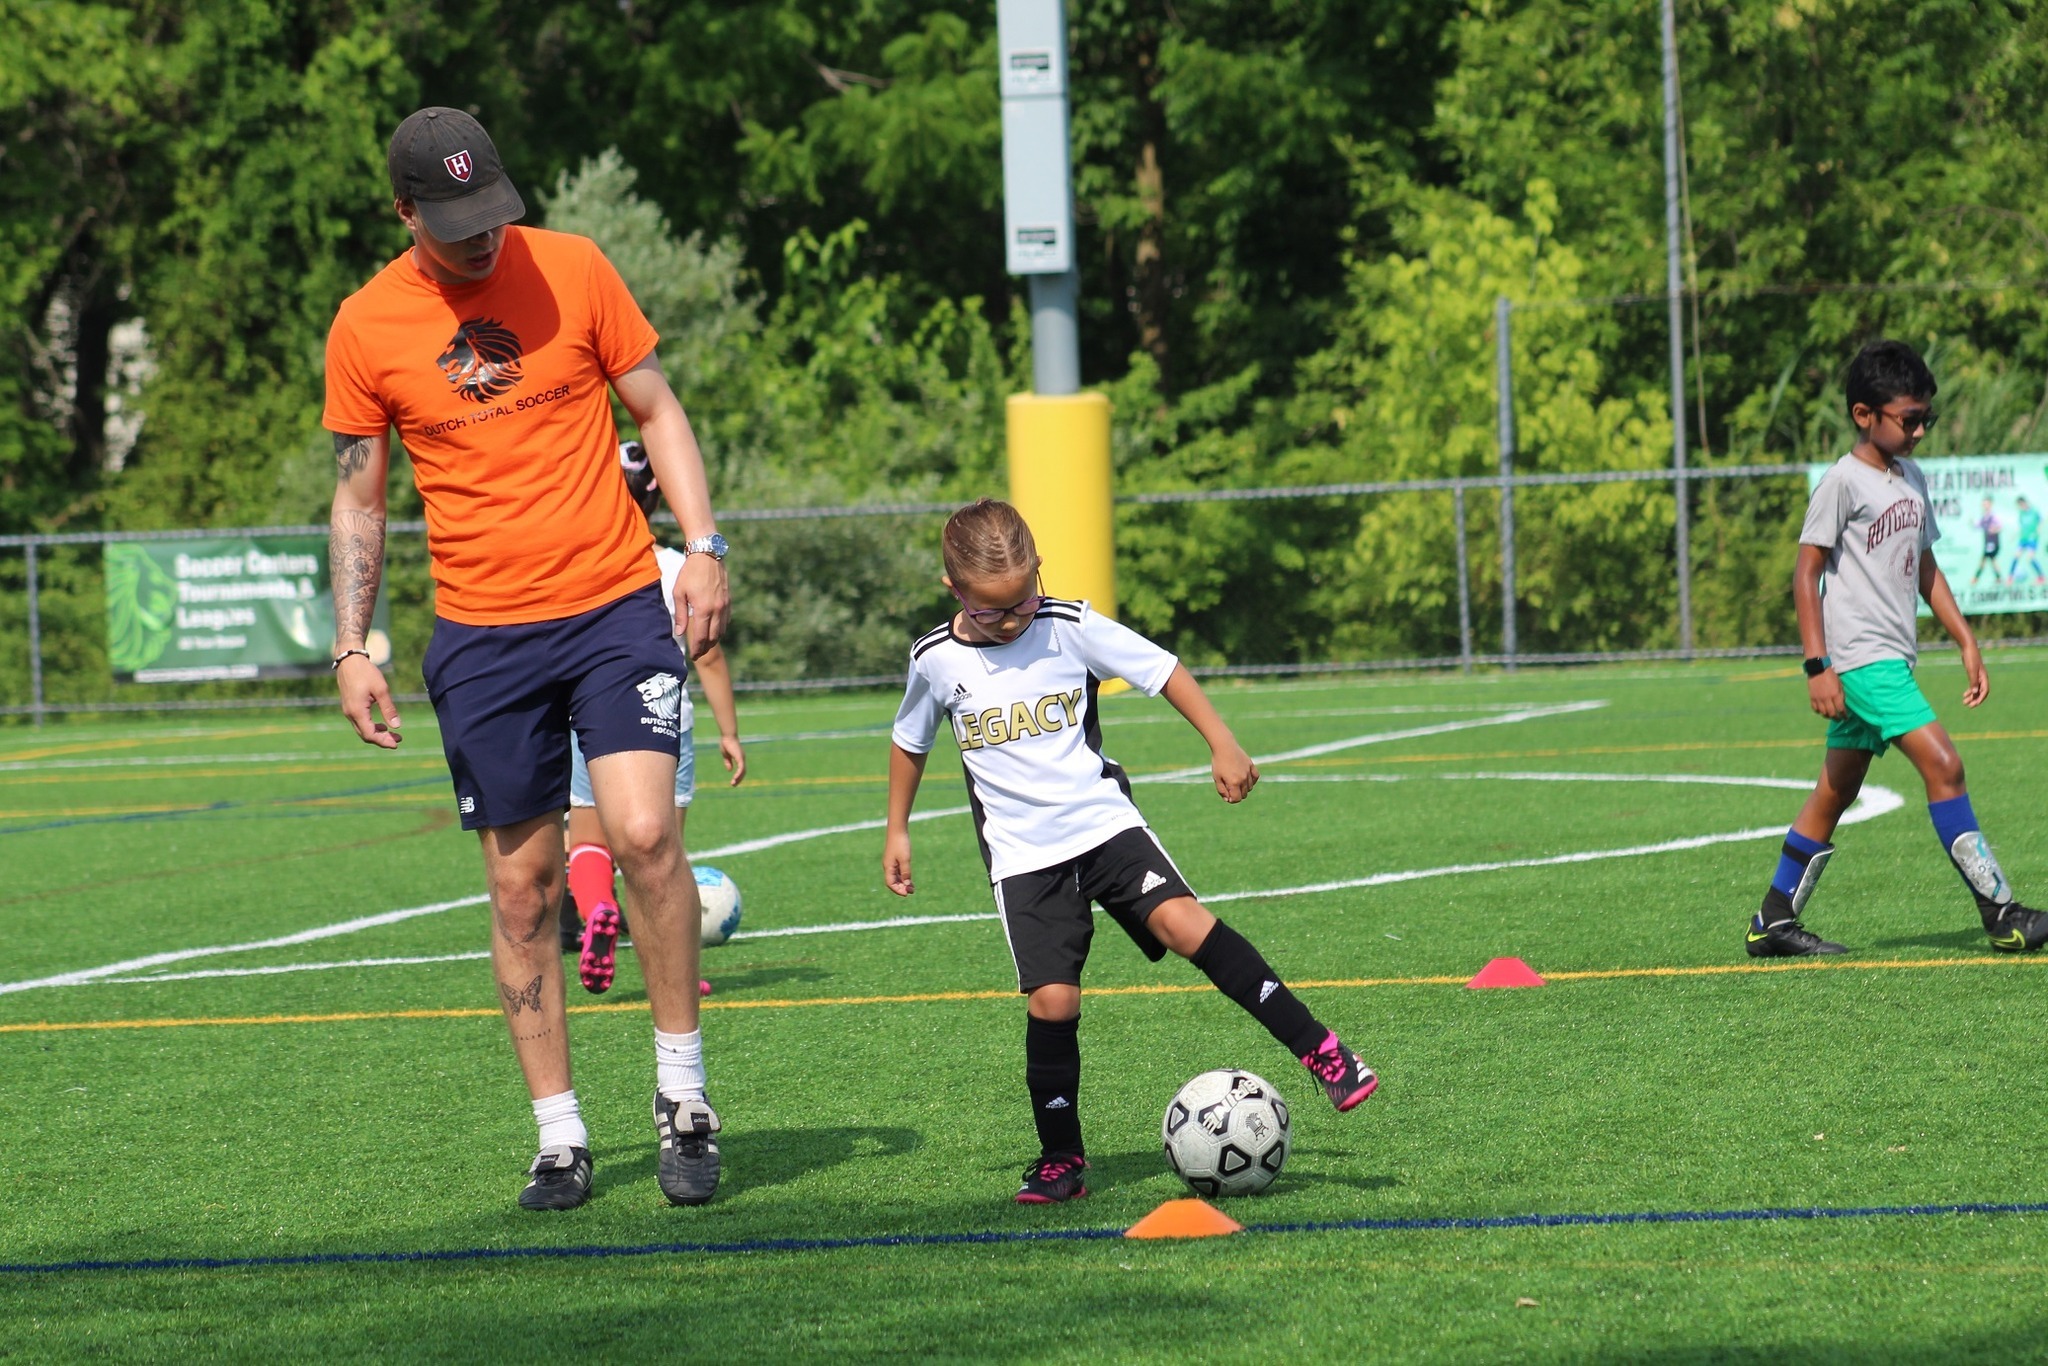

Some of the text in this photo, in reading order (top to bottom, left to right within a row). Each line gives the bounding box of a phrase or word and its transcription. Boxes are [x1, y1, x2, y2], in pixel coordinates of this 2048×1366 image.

[451, 155, 469, 175] H
[424, 385, 571, 436] DUTCH TOTAL SOCCER
[1866, 498, 1919, 555] RUTGERS
[175, 550, 319, 578] Soccer Centers
[177, 580, 296, 602] Tournaments
[176, 606, 256, 630] Leagues
[640, 716, 668, 727] DUTCH
[953, 687, 1083, 751] LEGACY
[1202, 1079, 1260, 1136] BRINE
